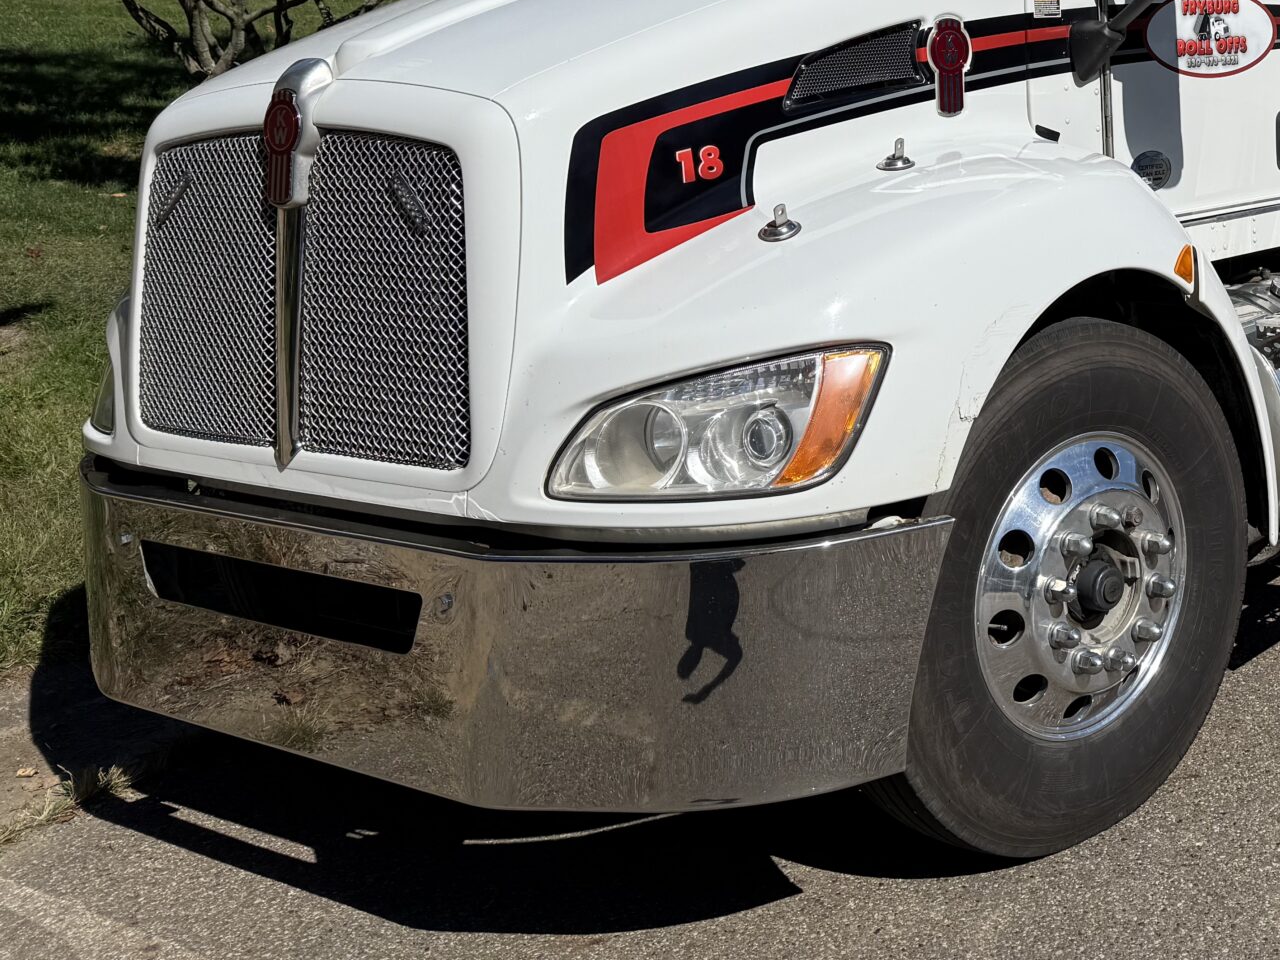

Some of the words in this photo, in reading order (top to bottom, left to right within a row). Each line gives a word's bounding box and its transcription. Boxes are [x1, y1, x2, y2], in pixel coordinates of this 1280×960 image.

[1176, 38, 1213, 57] ROLL
[1215, 36, 1247, 54] OFFS
[675, 144, 724, 184] 18
